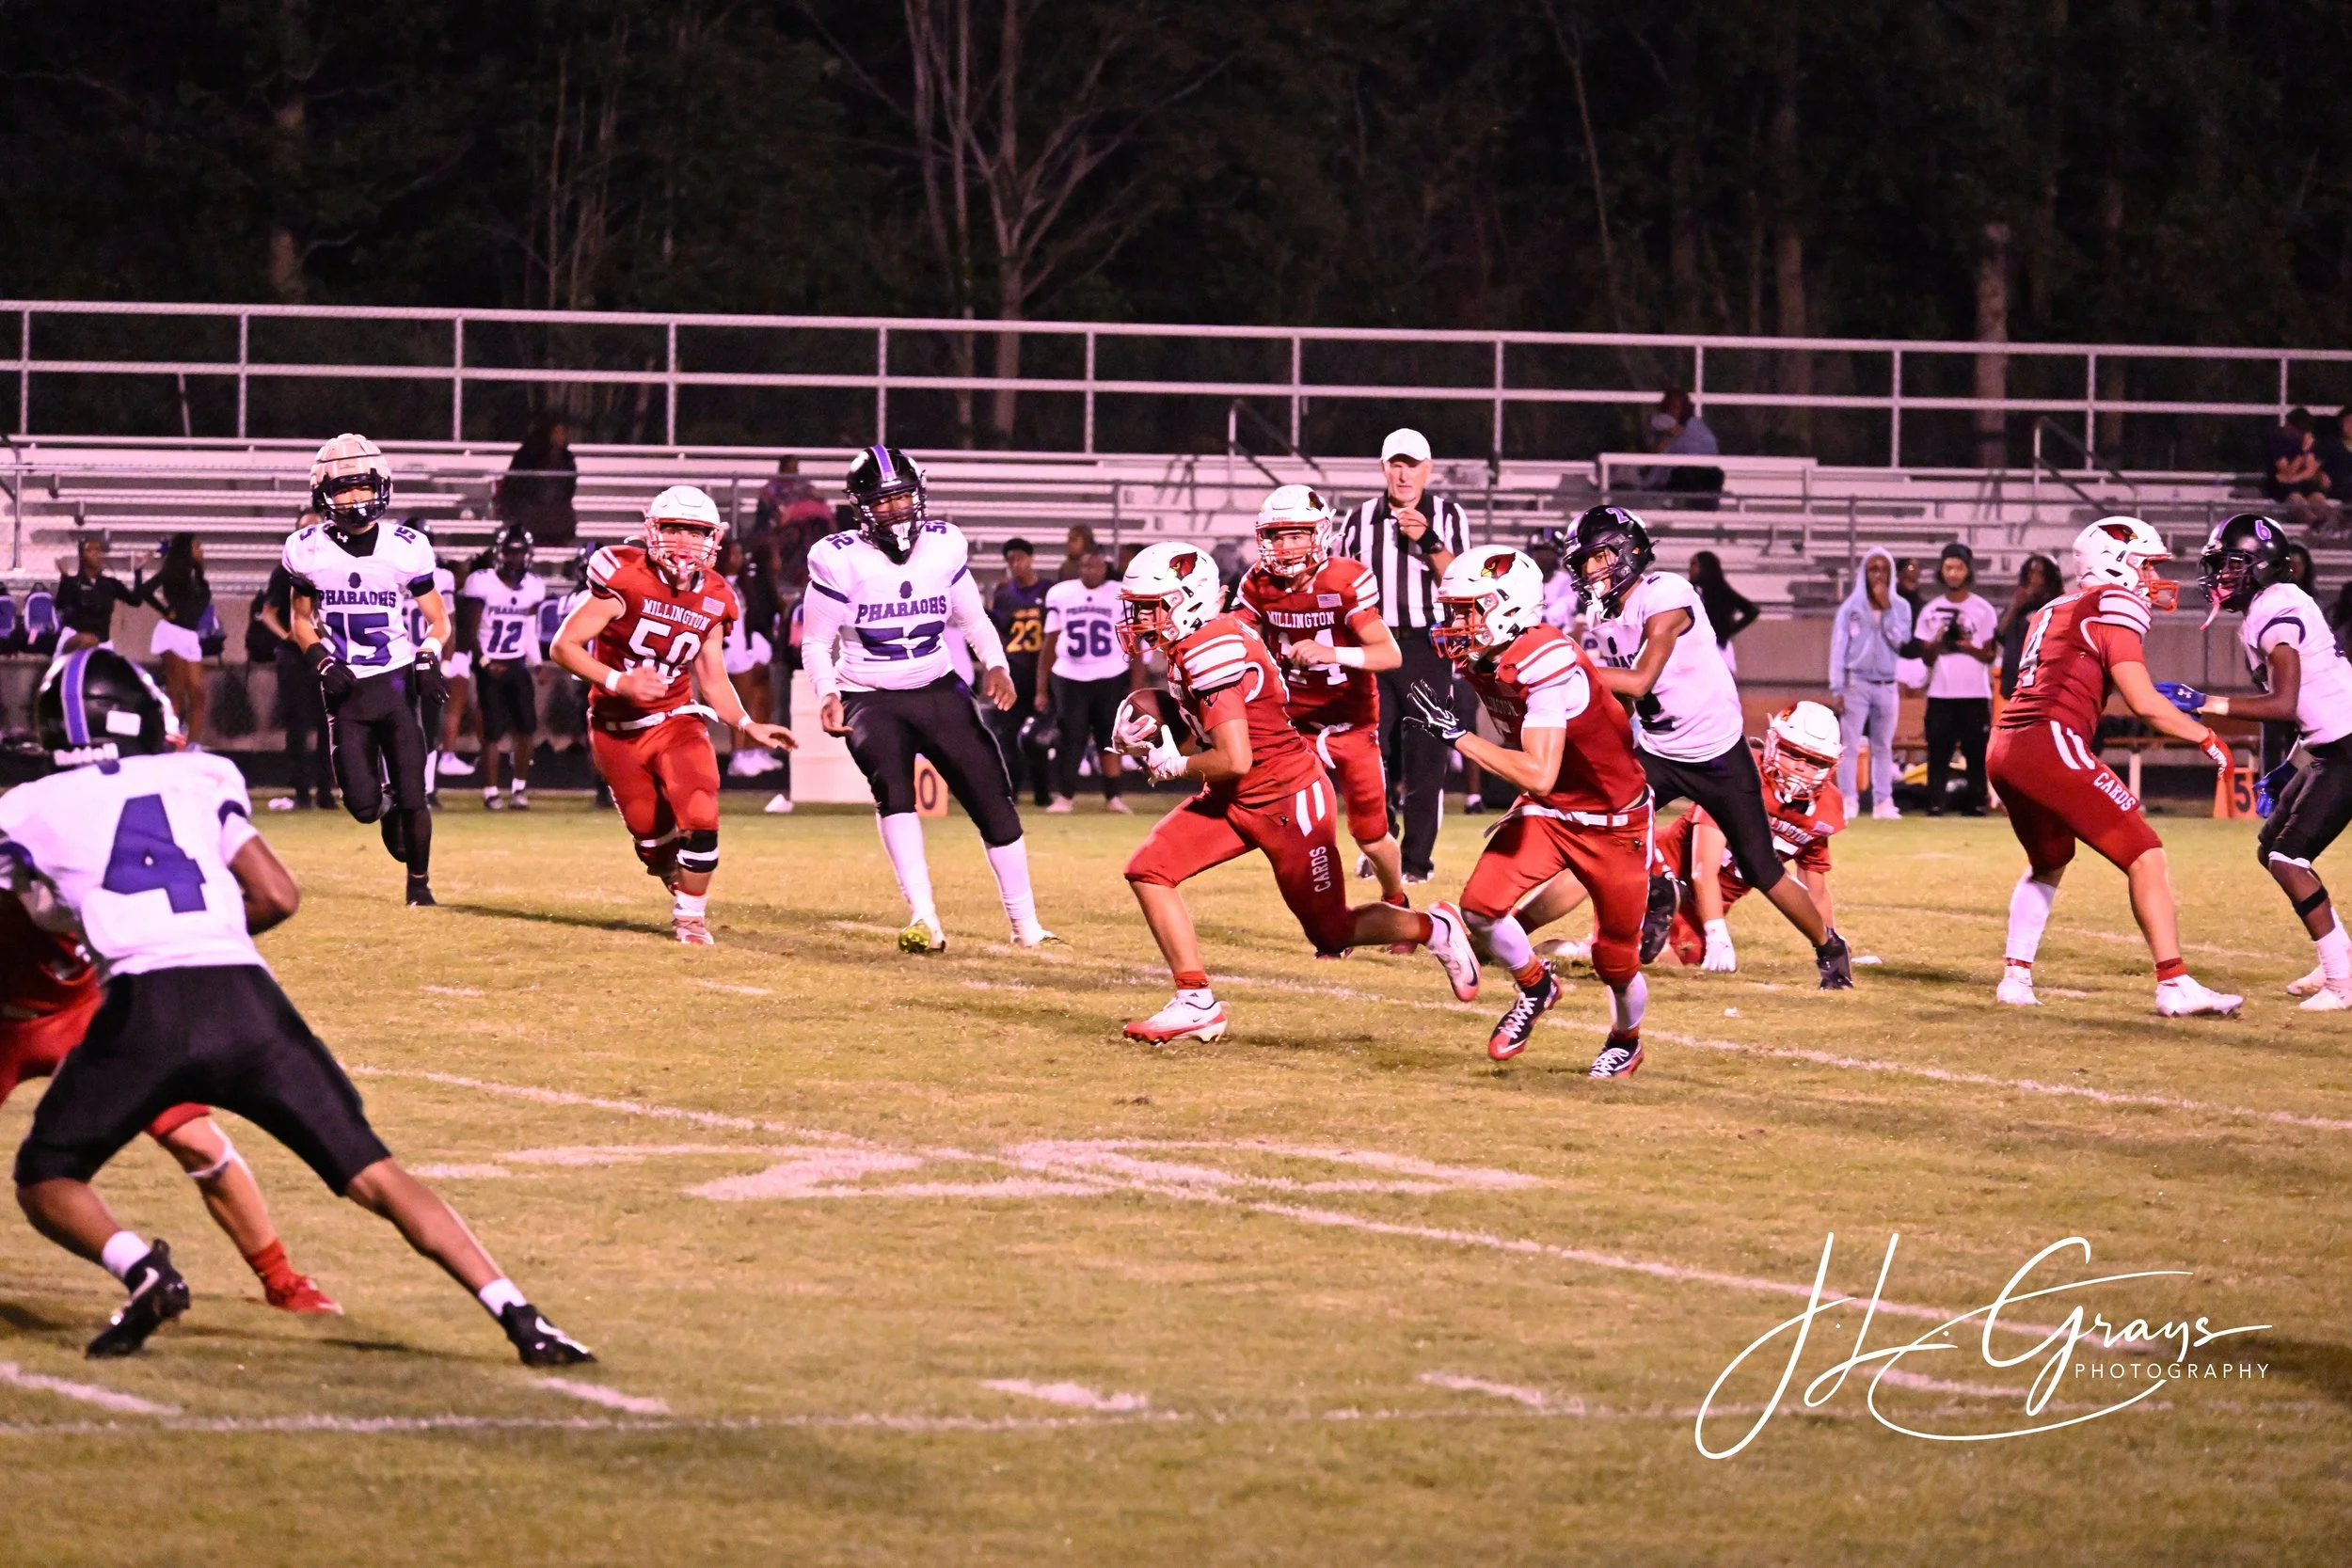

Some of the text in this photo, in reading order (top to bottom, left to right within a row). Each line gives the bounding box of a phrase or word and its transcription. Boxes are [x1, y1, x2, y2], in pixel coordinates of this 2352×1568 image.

[1605, 508, 1629, 525] 2
[2254, 519, 2272, 541] 6
[393, 526, 417, 545] 15
[318, 590, 397, 609] PHARAOHS
[642, 598, 711, 631] MILLINGTON
[854, 595, 947, 625] PHARAOHS
[487, 619, 524, 654] 12
[1006, 619, 1043, 653] 23
[1266, 610, 1336, 629] MILLINGTON
[325, 611, 392, 667] 15
[624, 617, 702, 686] 50
[854, 620, 946, 662] 52
[1066, 619, 1113, 657] 56
[1278, 627, 1348, 686] 14
[2093, 772, 2137, 812] CARDS
[103, 794, 207, 914] 4
[1309, 846, 1331, 893] CARDS
